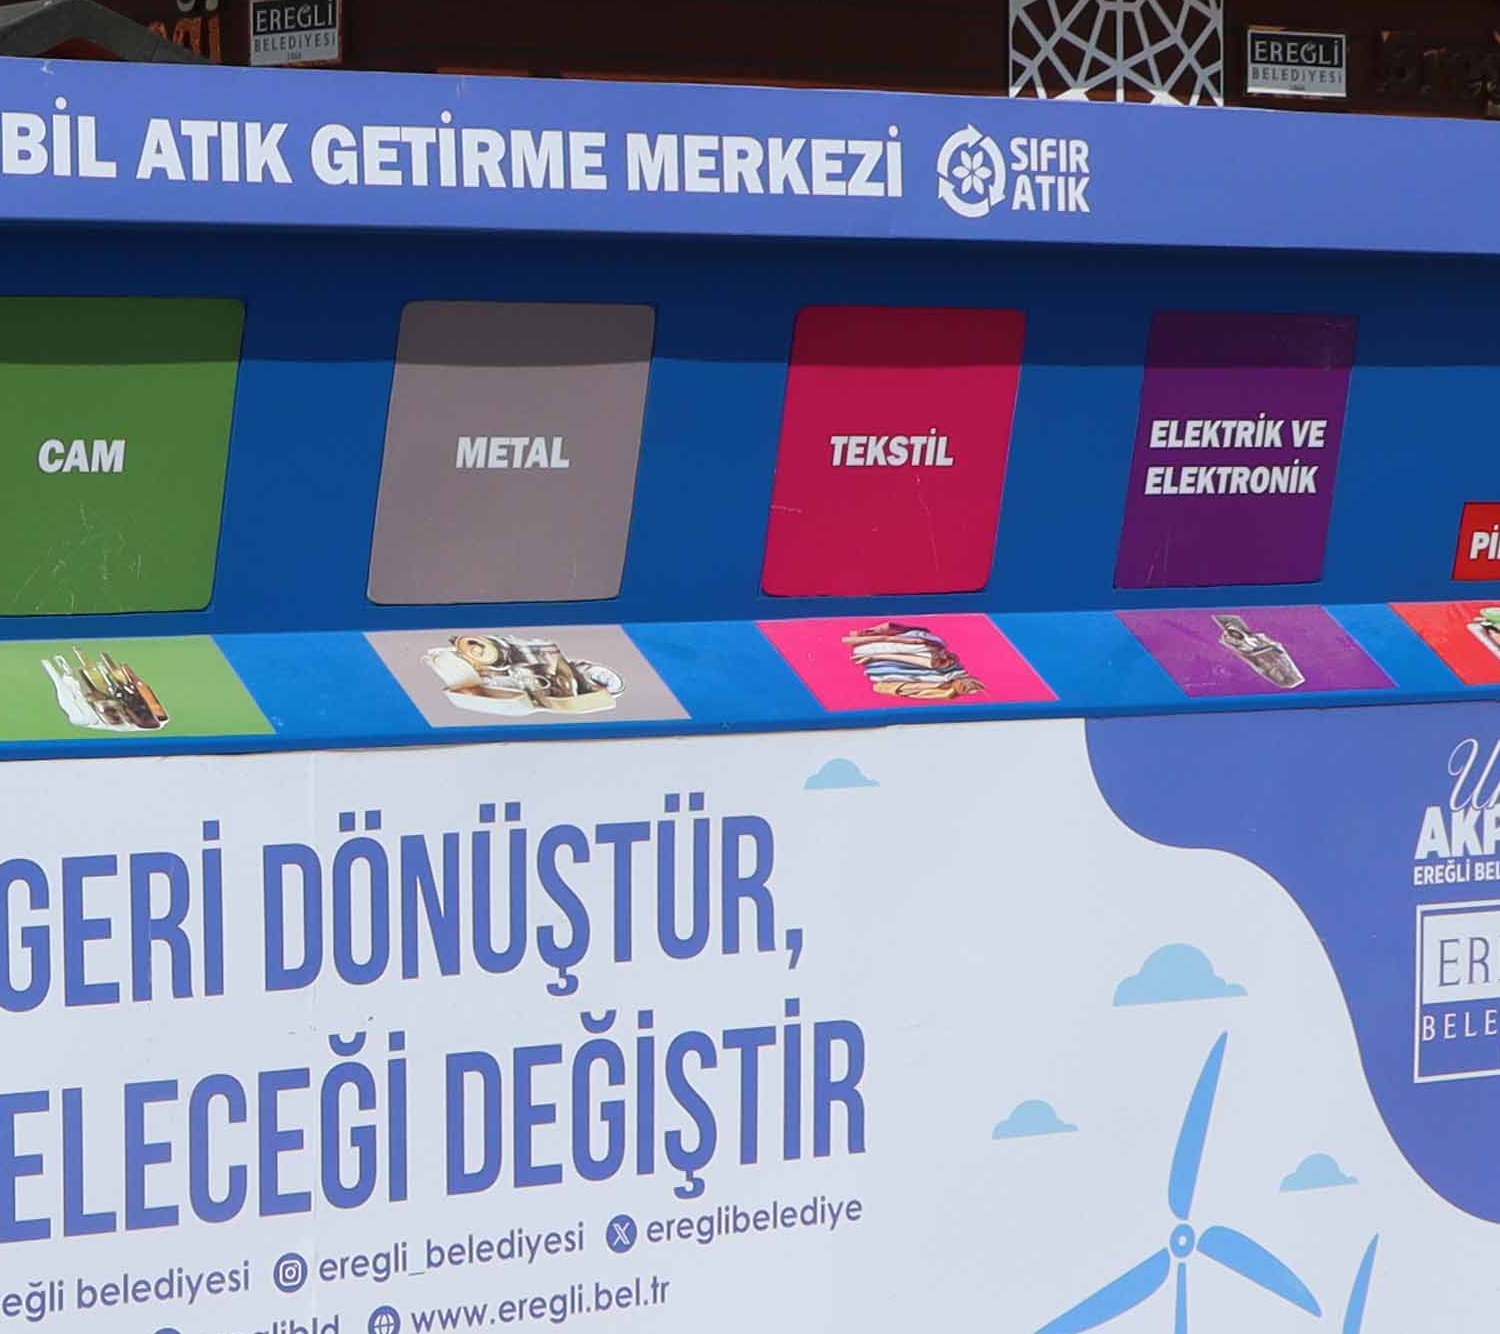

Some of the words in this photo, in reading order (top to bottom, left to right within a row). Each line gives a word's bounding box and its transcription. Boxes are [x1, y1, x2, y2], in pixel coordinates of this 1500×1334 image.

[135, 118, 293, 184] ATIK
[311, 110, 608, 192] GETİRME
[626, 124, 903, 198] MERKEZİ
[1010, 136, 1089, 175] SIFIR
[1011, 175, 1091, 213] ATIK
[830, 427, 955, 469] TEKSTİL
[1150, 412, 1286, 450] ELEKTRİK
[1290, 418, 1328, 449] VE
[36, 438, 126, 475] CAM
[455, 435, 570, 470] METAL
[1143, 459, 1318, 497] ELEKTRONİK
[1413, 859, 1471, 886] EREĞLİ
[262, 791, 805, 997] DÖNÜŞTÜR,
[446, 997, 867, 1200] DEĞİŞTİR
[76, 1260, 251, 1311] belediyesi
[318, 1221, 585, 1285] eregli_belediyesi
[646, 1195, 863, 1246] ereglibelediye
[411, 1275, 671, 1334] www.eregli.bel.tr
